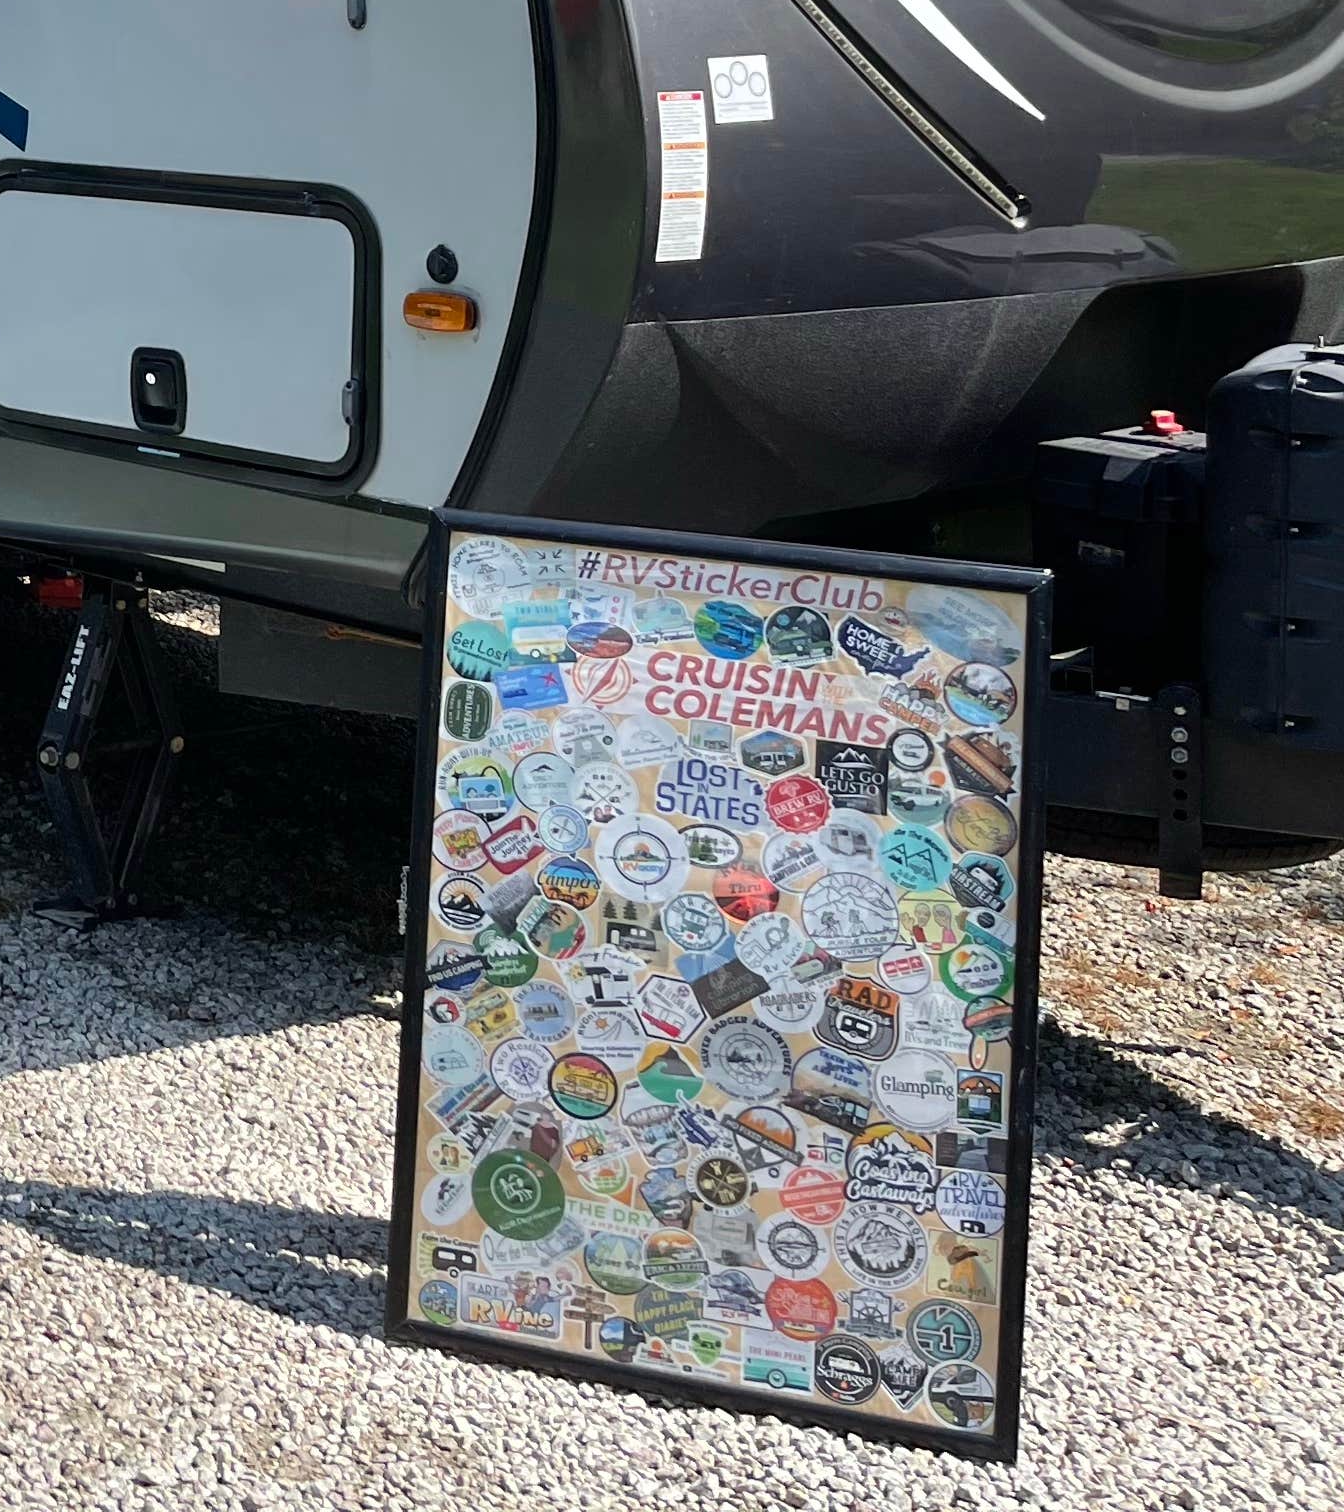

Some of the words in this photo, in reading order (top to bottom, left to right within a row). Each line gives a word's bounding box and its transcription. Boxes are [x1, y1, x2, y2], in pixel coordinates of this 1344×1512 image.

[578, 551, 883, 612] #RVStickerClub
[451, 630, 474, 650] Get
[478, 644, 508, 662] Lost
[845, 636, 900, 664] SWEET
[847, 623, 891, 653] HOME
[57, 624, 89, 709] EAZ-LIFT
[462, 684, 476, 739] ADVENTURES
[644, 685, 889, 746] COLEMANS
[879, 698, 941, 736] CAMPER
[882, 685, 950, 725] HAPPY
[488, 723, 550, 748] AMATEUR
[676, 758, 742, 791] LOST
[697, 782, 710, 794] IN
[821, 767, 855, 780] LETS
[859, 771, 885, 784] GO
[825, 780, 880, 795] GUSTO
[656, 782, 760, 826] STATES
[773, 797, 805, 816] BREW
[807, 791, 825, 803] RV
[501, 833, 532, 858] Journey
[953, 867, 1004, 913] AIRSTREAM
[838, 979, 891, 1009] RAD
[701, 1038, 711, 1068] SILVER
[709, 1016, 747, 1034] BADGER
[752, 1019, 792, 1076] ADVENTURES
[880, 1075, 955, 1101] Glamping
[959, 1172, 981, 1187] RV
[846, 1181, 935, 1214] Castaways
[850, 1204, 878, 1218] HOW
[885, 1205, 904, 1215] WE
[940, 1187, 1006, 1208] TRAVEL
[568, 1201, 610, 1218] THE
[613, 1211, 654, 1227] DRY
[477, 1283, 499, 1296] ART
[637, 1306, 666, 1321] HAPPY
[668, 1301, 695, 1314] PLACE
[940, 1326, 955, 1352] 1
